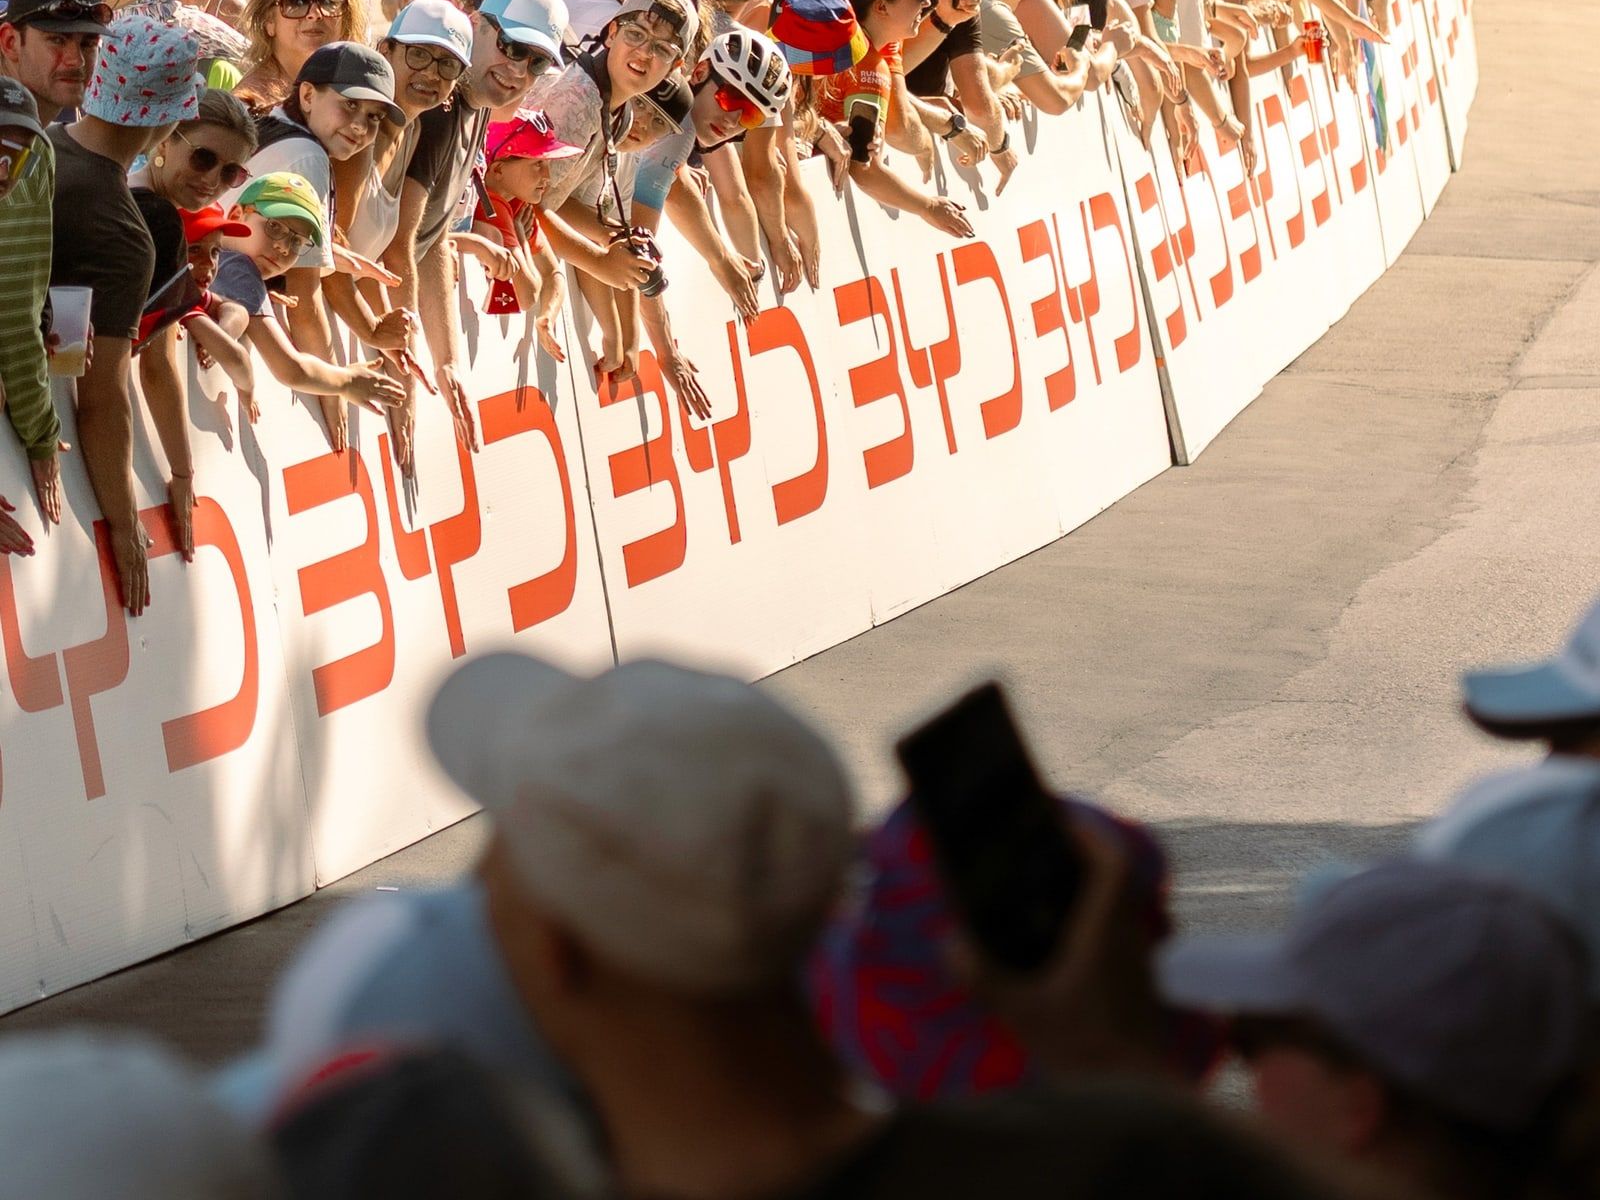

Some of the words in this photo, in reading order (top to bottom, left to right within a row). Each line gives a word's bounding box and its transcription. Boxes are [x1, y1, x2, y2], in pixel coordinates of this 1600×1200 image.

[1017, 192, 1141, 412] BYD
[1135, 143, 1234, 351] BYD
[1215, 94, 1306, 284] BYD
[598, 306, 829, 588] BYD
[833, 241, 1023, 490] BYD
[0, 495, 259, 801] YD
[282, 385, 578, 718] BYD
